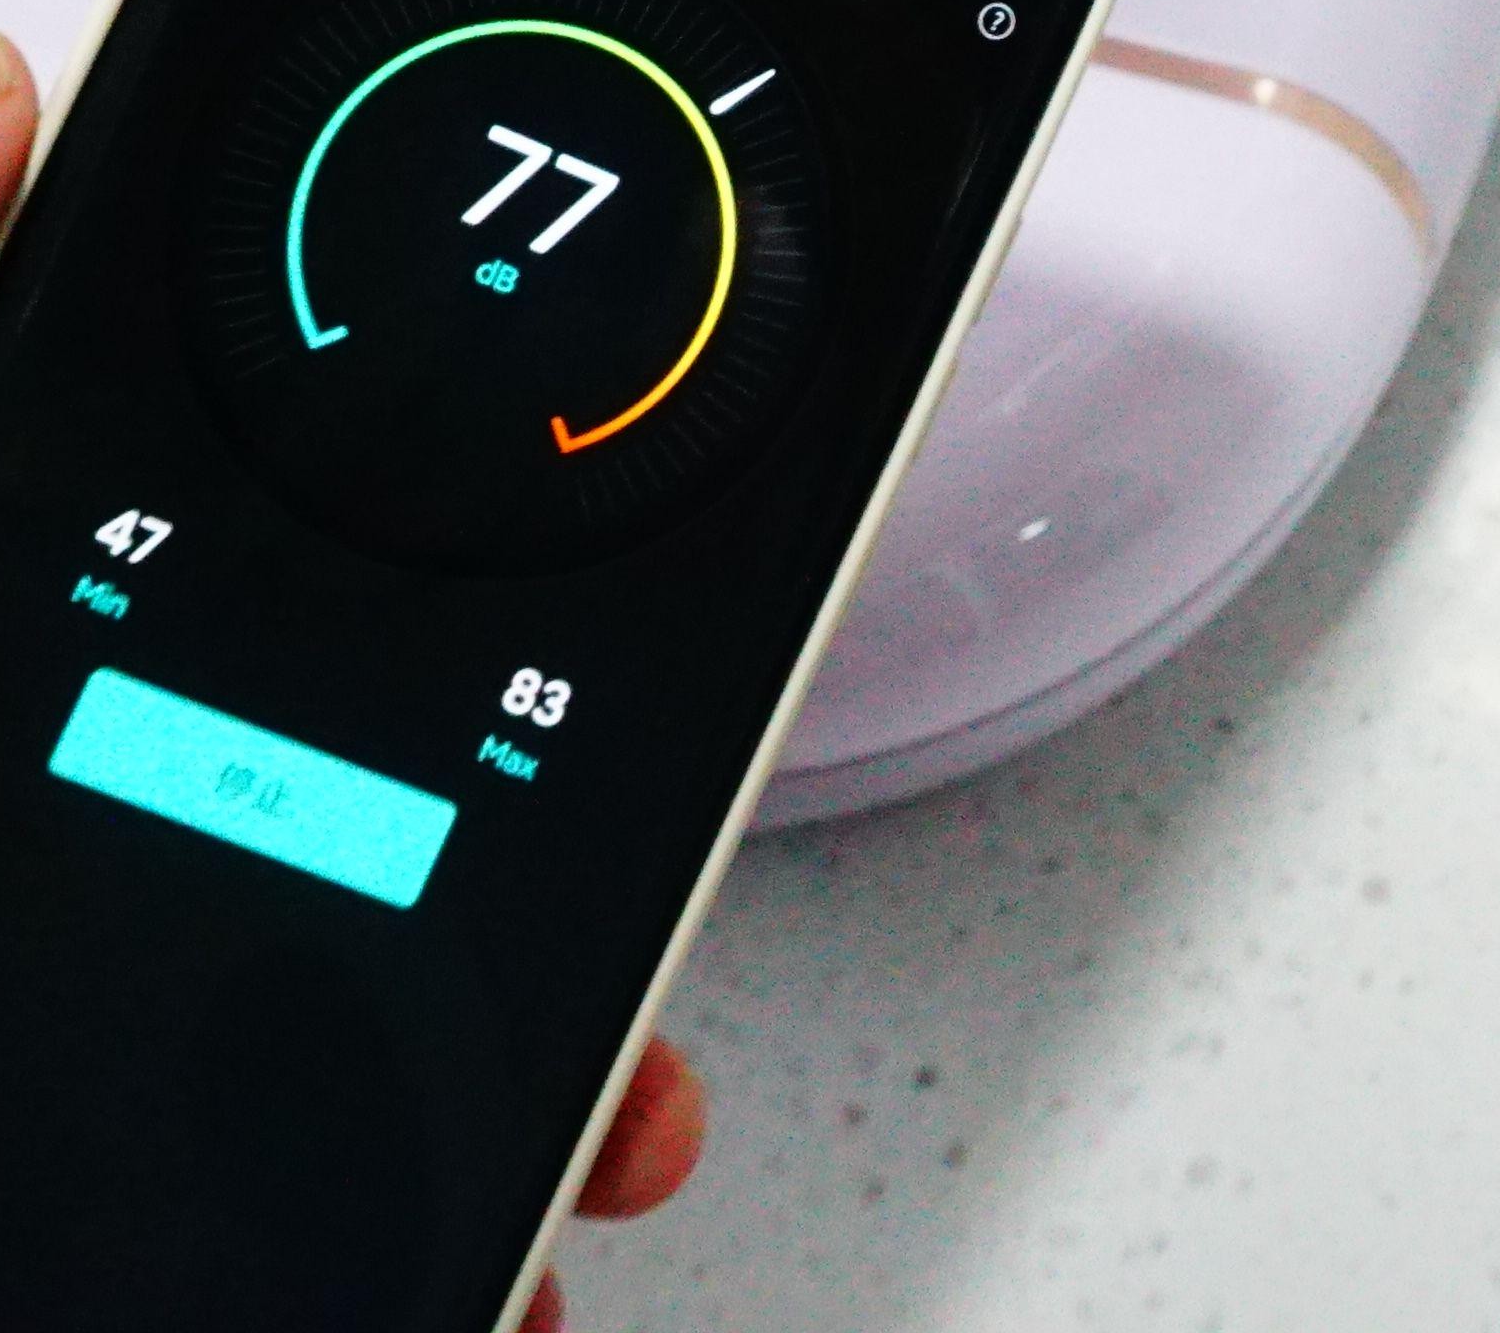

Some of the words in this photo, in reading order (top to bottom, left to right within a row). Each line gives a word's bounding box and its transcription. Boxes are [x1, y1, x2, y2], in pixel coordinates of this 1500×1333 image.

[460, 124, 621, 255] 77
[474, 258, 520, 295] dB
[94, 509, 174, 565] 47
[71, 574, 130, 620] Min
[500, 667, 572, 728] 83
[477, 734, 539, 781] Max
